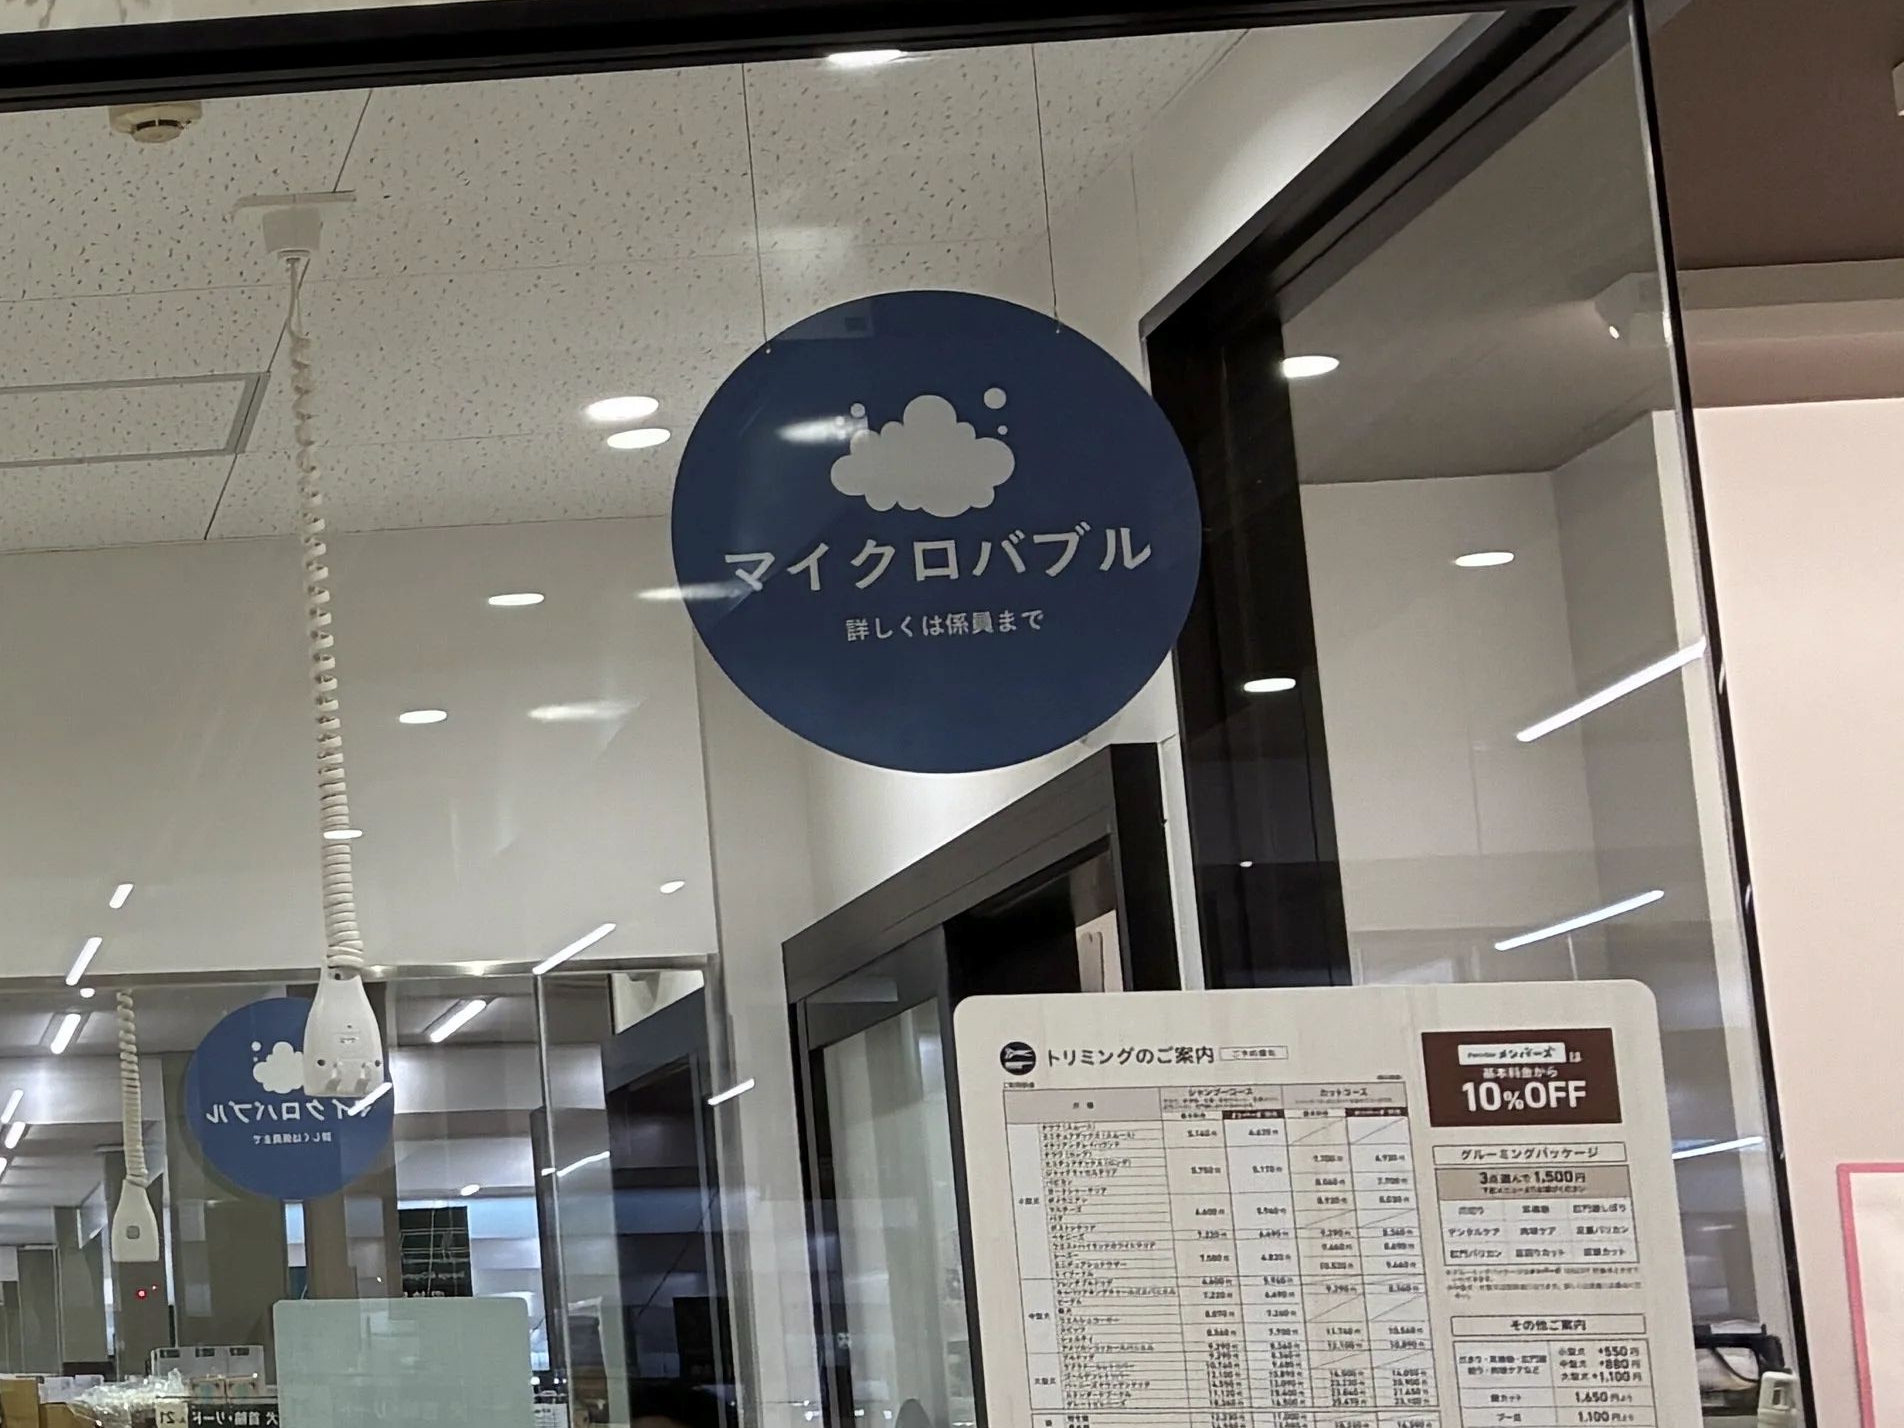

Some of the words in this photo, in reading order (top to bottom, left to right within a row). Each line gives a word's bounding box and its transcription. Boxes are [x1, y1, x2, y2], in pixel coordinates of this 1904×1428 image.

[725, 521, 1151, 592] マイクロバブル
[846, 610, 1044, 642] 詳しくは係員まで
[1047, 1046, 1214, 1065] トリミングのご案内
[1483, 1067, 1558, 1079] 基本料金から
[1462, 1081, 1586, 1112] 10%OFF
[1461, 1148, 1598, 1160] グルーミングパッケージ
[1510, 1320, 1587, 1331] その他ご案内
